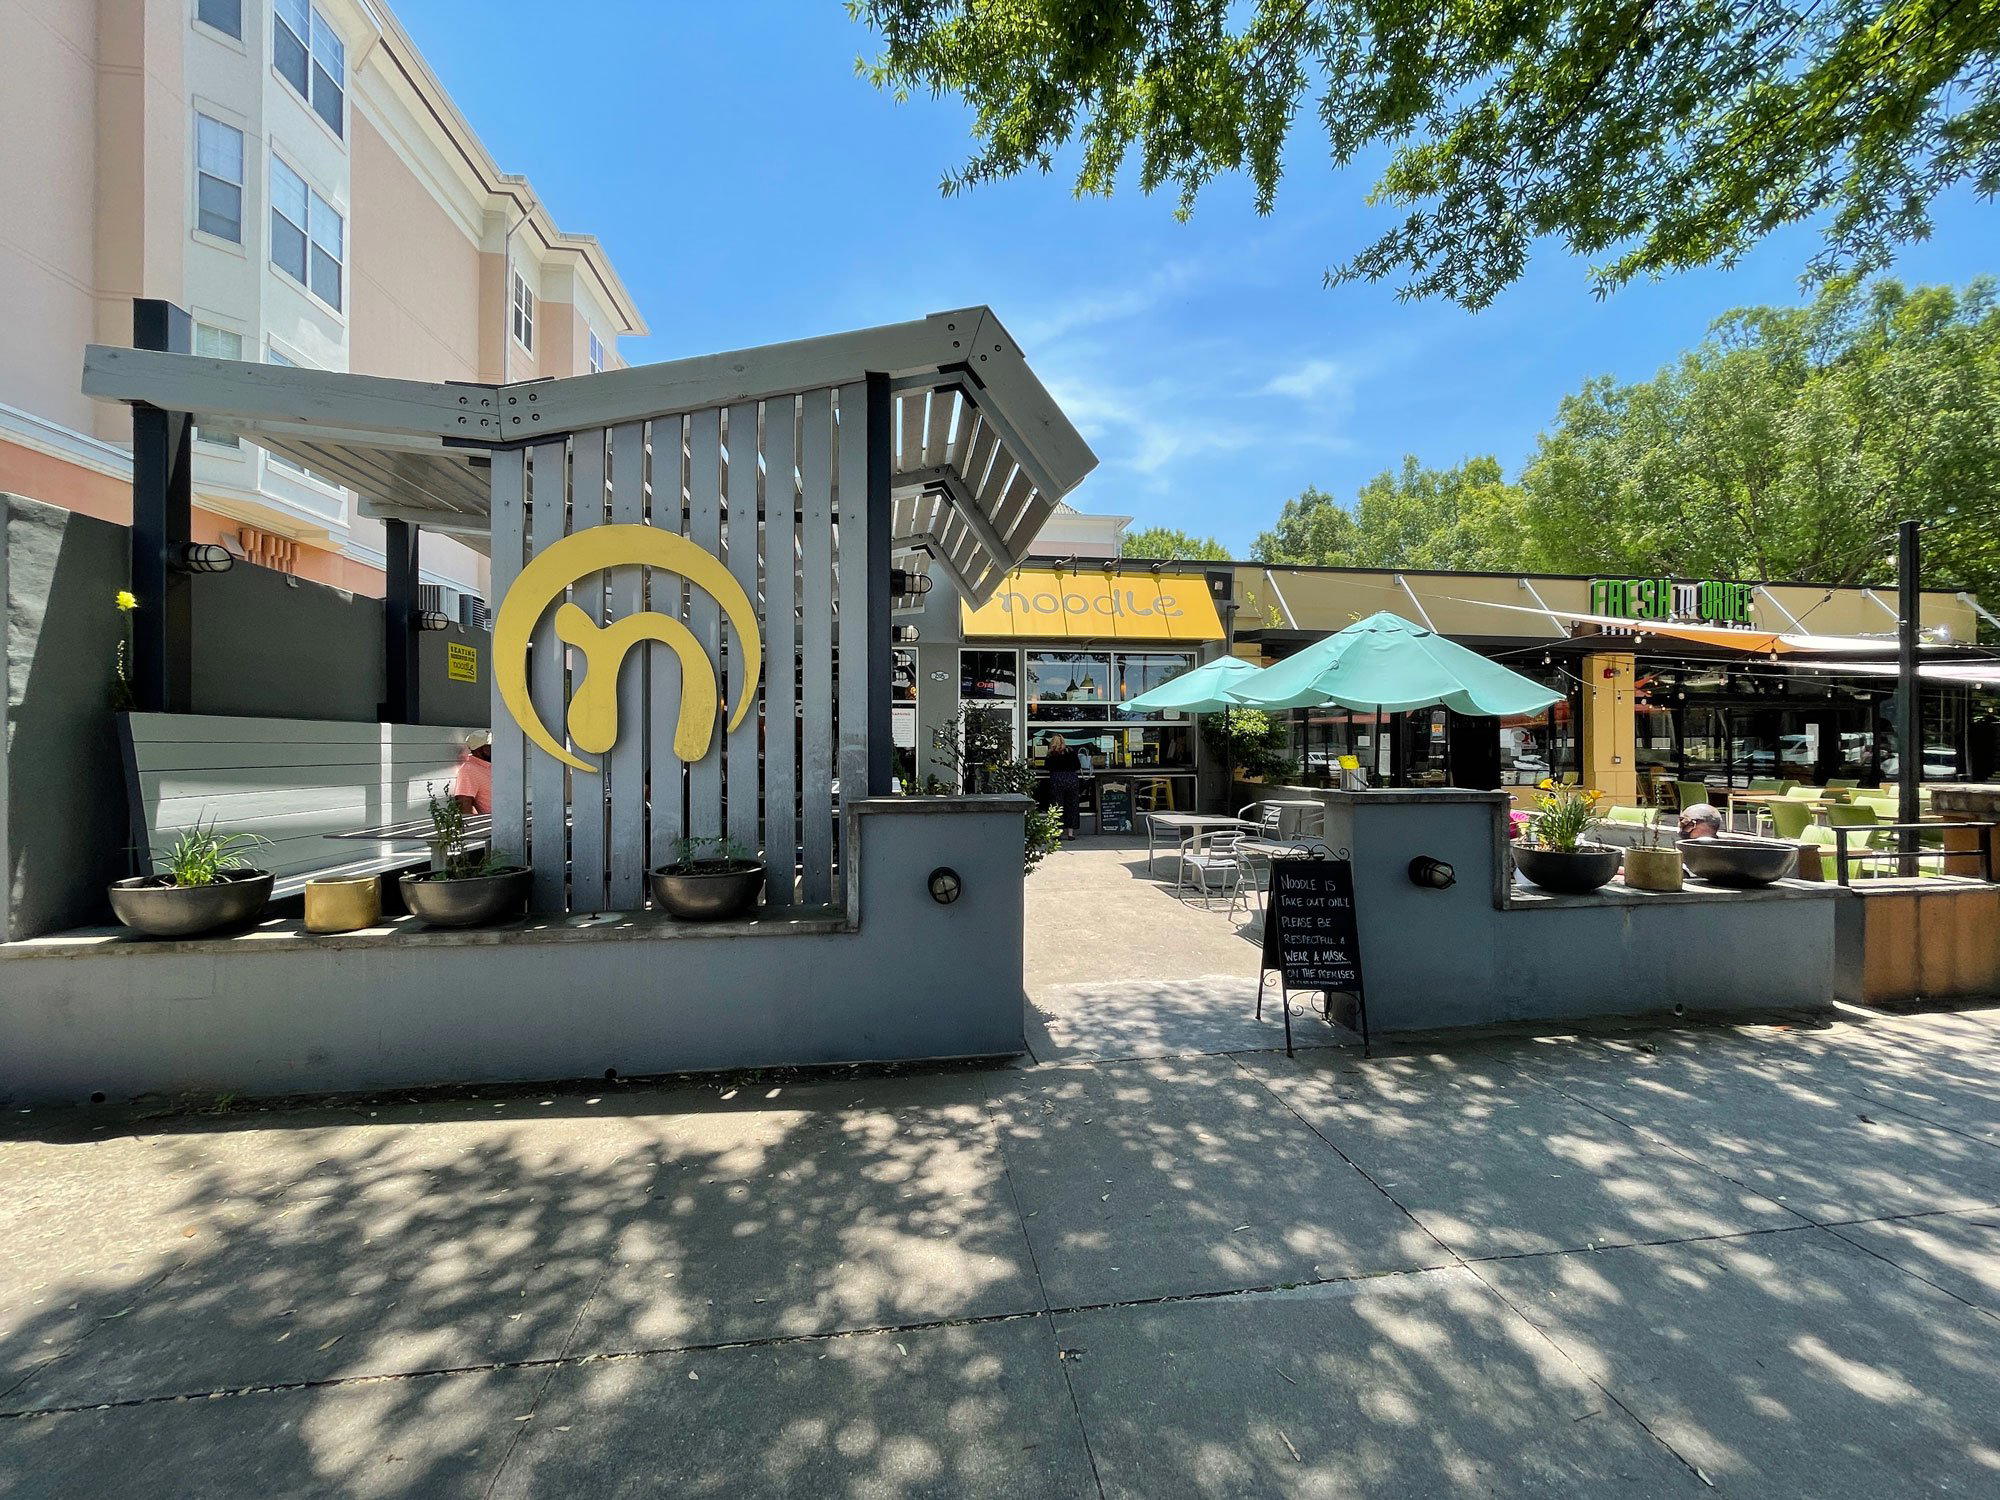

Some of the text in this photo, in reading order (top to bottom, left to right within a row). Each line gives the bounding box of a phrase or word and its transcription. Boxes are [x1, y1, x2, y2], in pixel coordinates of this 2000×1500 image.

[996, 589, 1183, 617] noodle
[1592, 579, 1671, 619] FRESH
[1677, 585, 1695, 614] TO
[1280, 874, 1336, 891] NOODLE IS
[1281, 895, 1303, 906] TAKE
[1306, 898, 1325, 907] OUT
[1281, 916, 1331, 928] PLEASE BE
[1283, 934, 1336, 945] RESPECTFUL
[1284, 950, 1348, 962] WEAR A MASK
[1286, 968, 1355, 979] ON THE PREMISES
